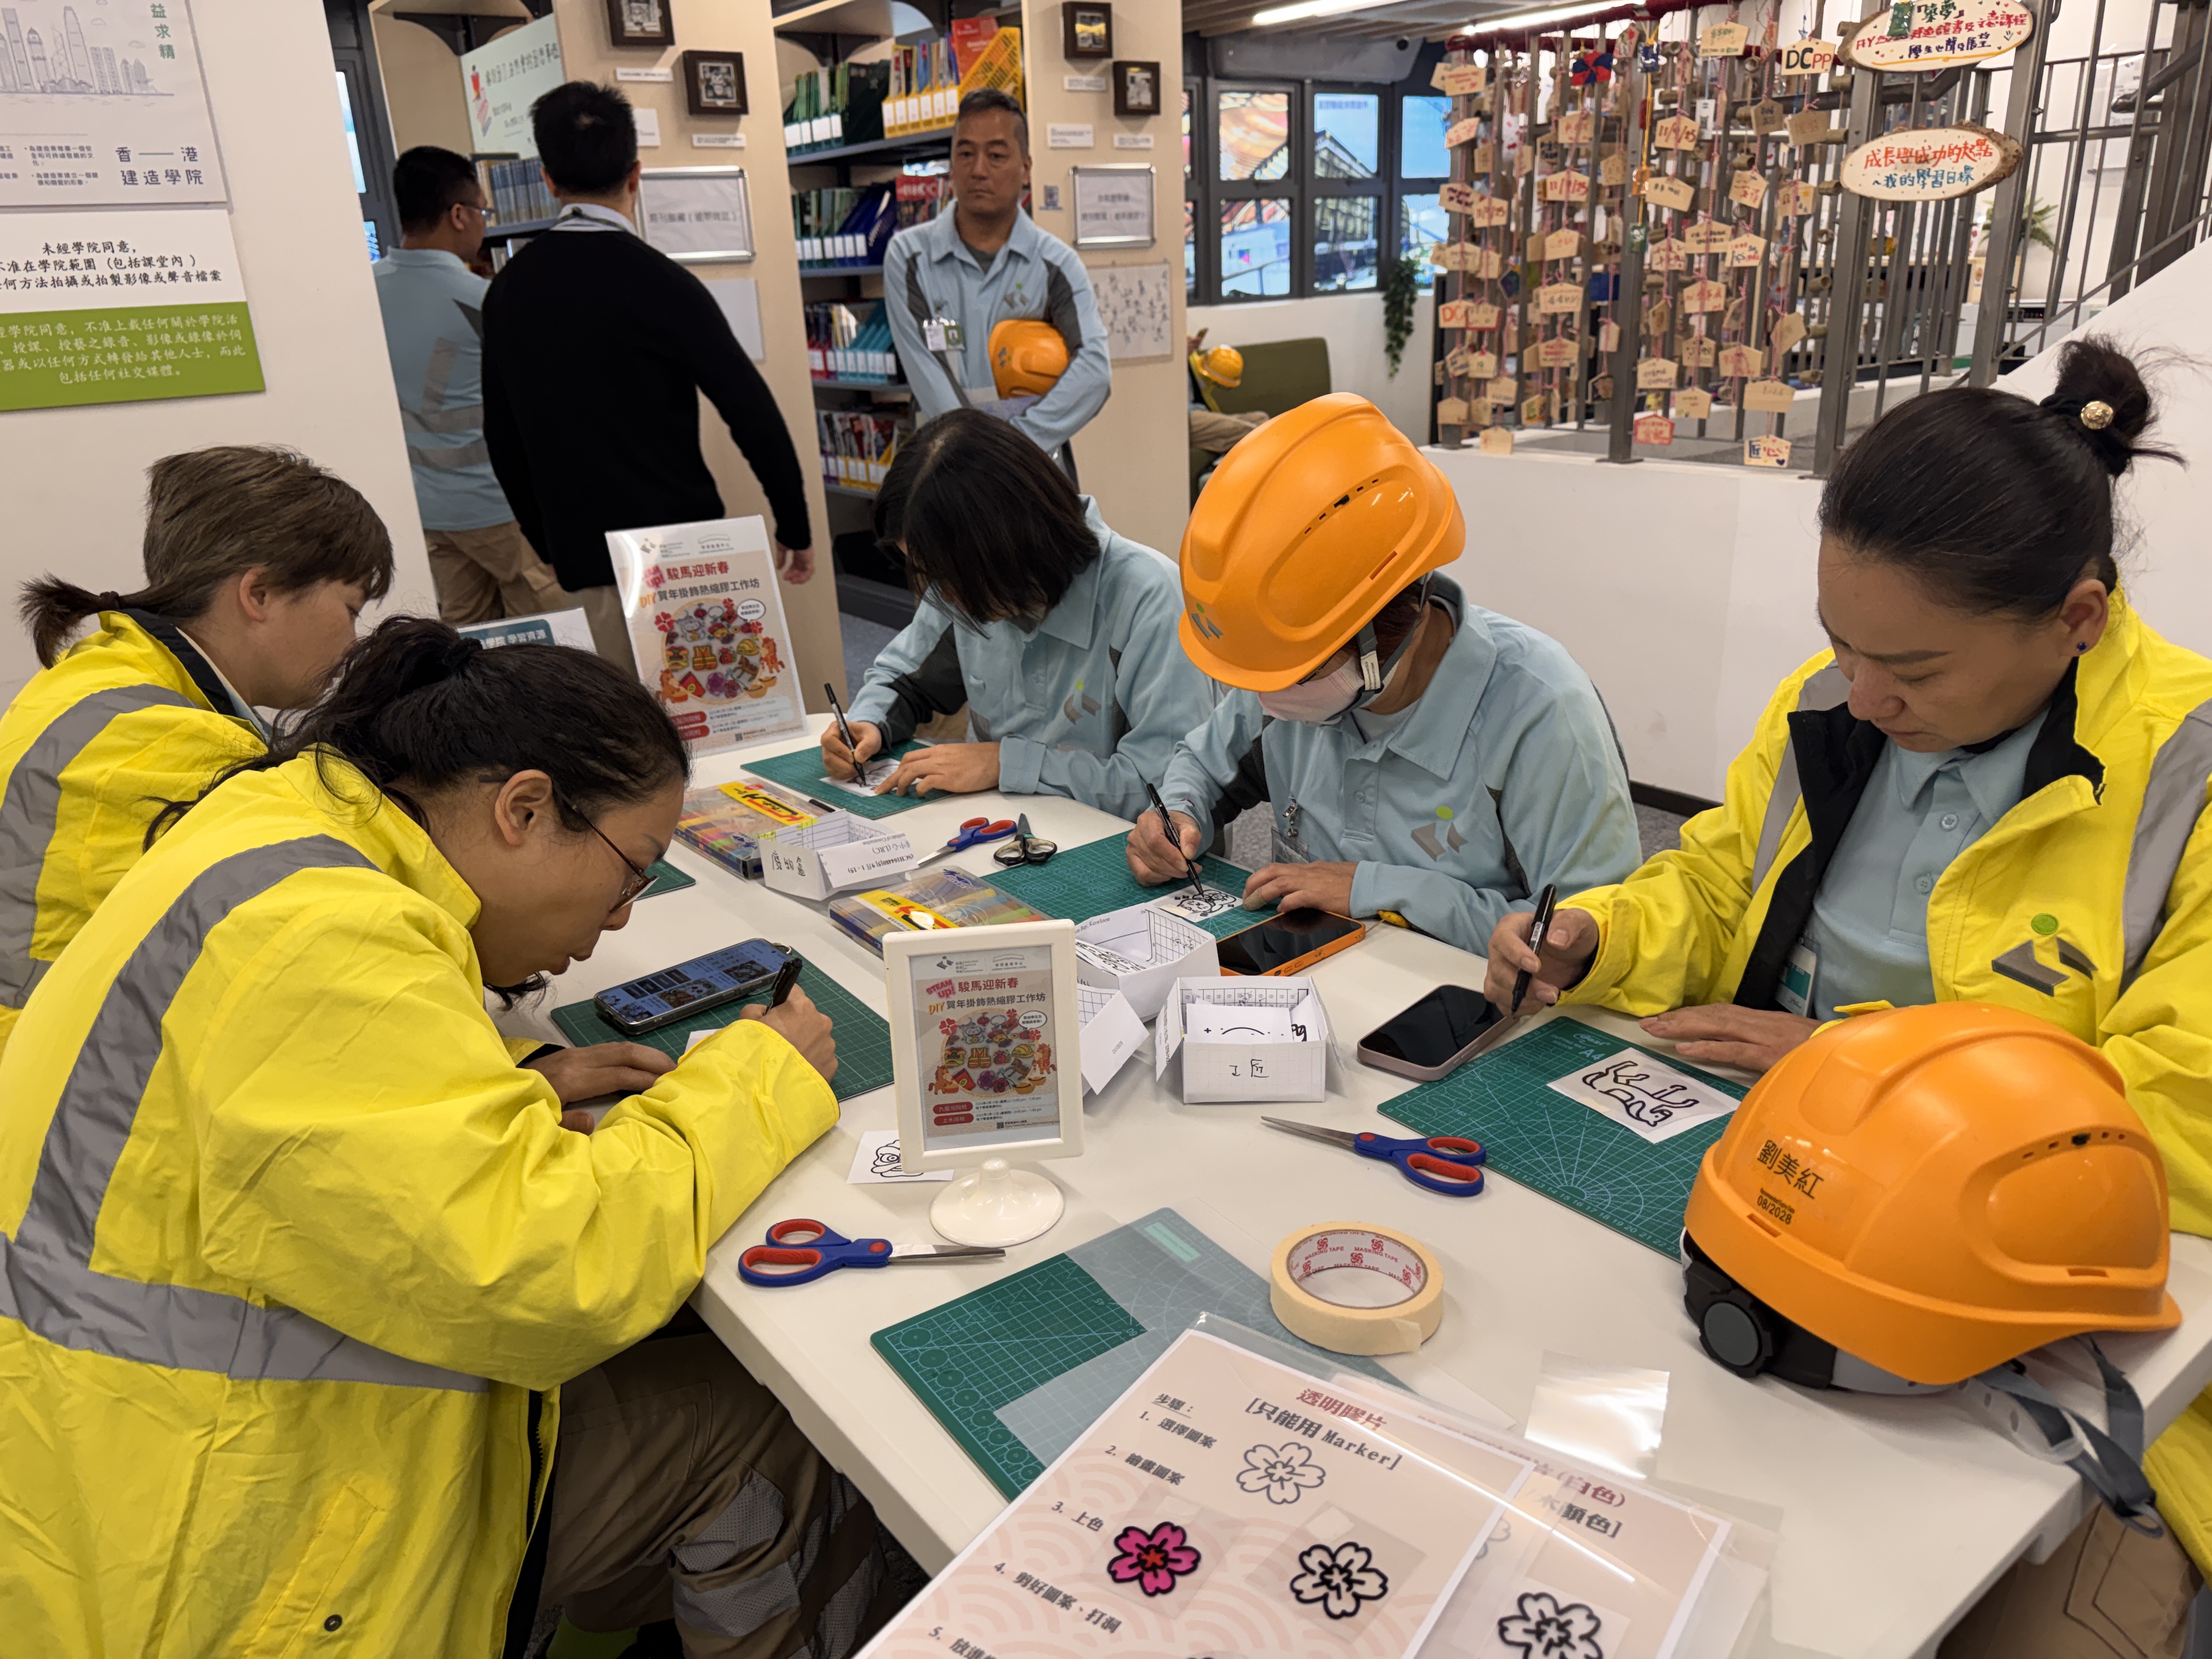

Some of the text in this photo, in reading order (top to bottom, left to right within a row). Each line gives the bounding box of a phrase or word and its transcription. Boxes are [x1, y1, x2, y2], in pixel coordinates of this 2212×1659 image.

[1785, 47, 1832, 70] DCPP
[120, 169, 204, 185] 建造學院
[665, 560, 730, 581] 駿馬迎新春
[657, 577, 760, 602] 賀年掛飾熱縮膠工作坊
[872, 845, 891, 854] (LRC)
[1089, 917, 1111, 927] Kowloon
[926, 979, 953, 995] STEAM
[958, 977, 1019, 993] 駿馬迎新春
[928, 992, 1046, 1015] DIY 賀年掛飾熱縮膠工作坊
[1578, 1048, 1606, 1060] A4
[1757, 1139, 1824, 1199] 劉美紅
[1757, 1195, 1792, 1224] 08/2028
[1599, 1212, 1610, 1221] 18
[1612, 1219, 1624, 1227] 19
[1639, 1232, 1651, 1240] 21
[1652, 1238, 1668, 1248] 22
[1667, 1245, 1681, 1255] 23
[1305, 1248, 1328, 1260] MASKING
[1355, 1246, 1398, 1263] MASKING TAPE
[1154, 1393, 1194, 1412] 步驟：
[1296, 1387, 1387, 1431] 透明膠片
[1139, 1411, 1217, 1449] 1. 選擇圖案
[1245, 1397, 1323, 1438] [只能用
[1321, 1430, 1403, 1471] Marker]
[1105, 1445, 1186, 1486] 2. 繪畫圖案
[1051, 1501, 1104, 1532] 3. 上色
[994, 1562, 1122, 1634] 4. 剪好圖案、打洞
[927, 1626, 944, 1640] 5.
